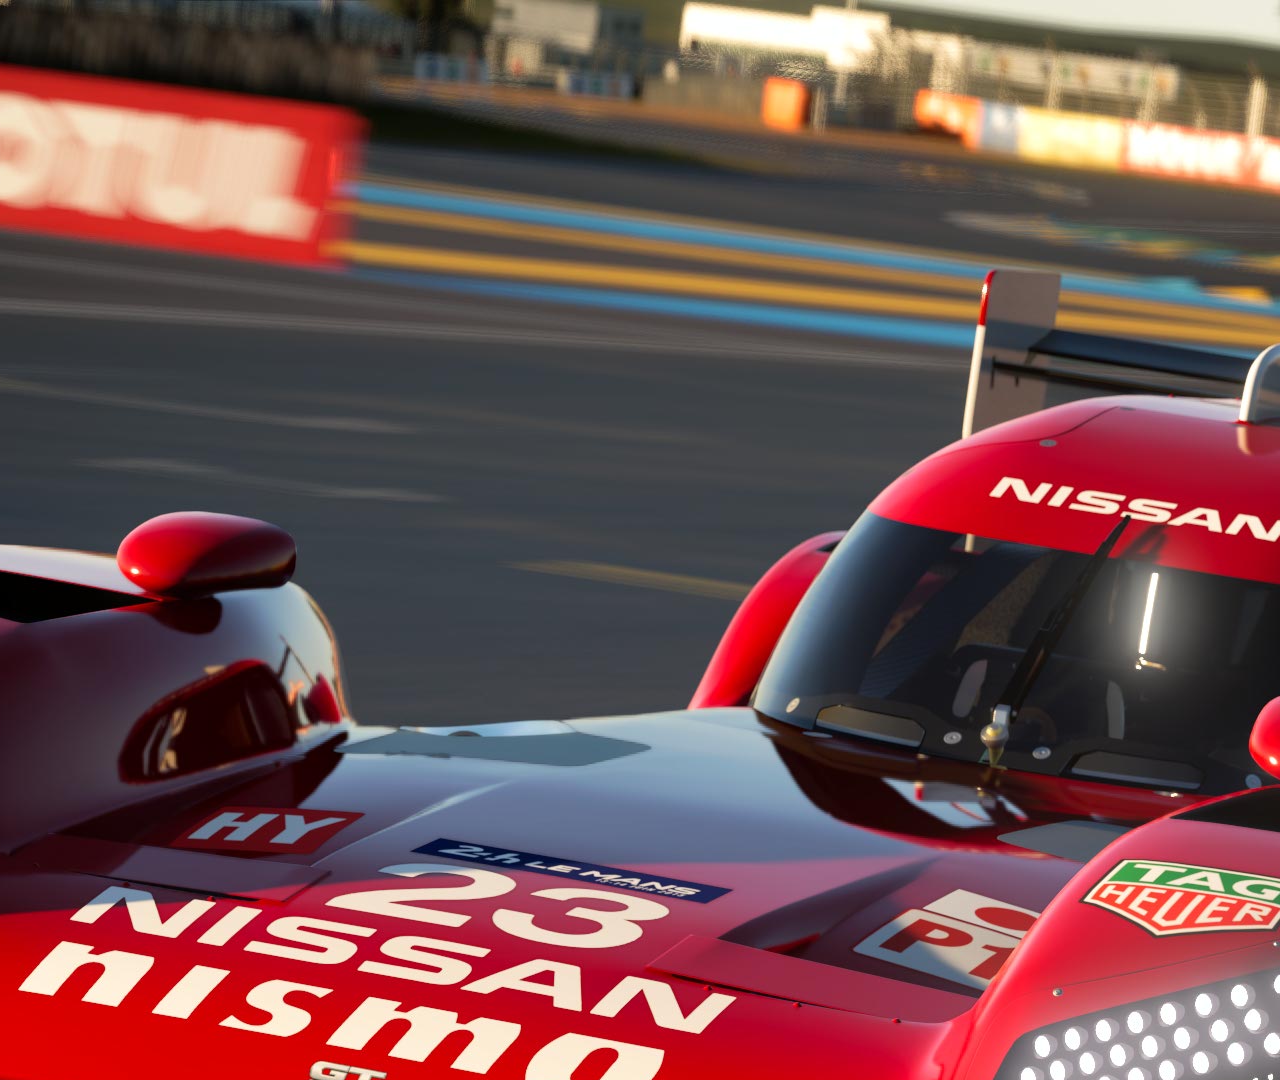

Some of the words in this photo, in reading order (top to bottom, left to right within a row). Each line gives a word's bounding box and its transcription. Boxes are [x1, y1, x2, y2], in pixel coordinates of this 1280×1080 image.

[187, 812, 346, 845] HY
[524, 861, 581, 874] LE
[579, 870, 702, 895] MANS
[325, 863, 670, 949] 23
[1098, 883, 1269, 929] HEUER
[70, 886, 737, 1034] NISSAN
[879, 918, 1016, 980] P1
